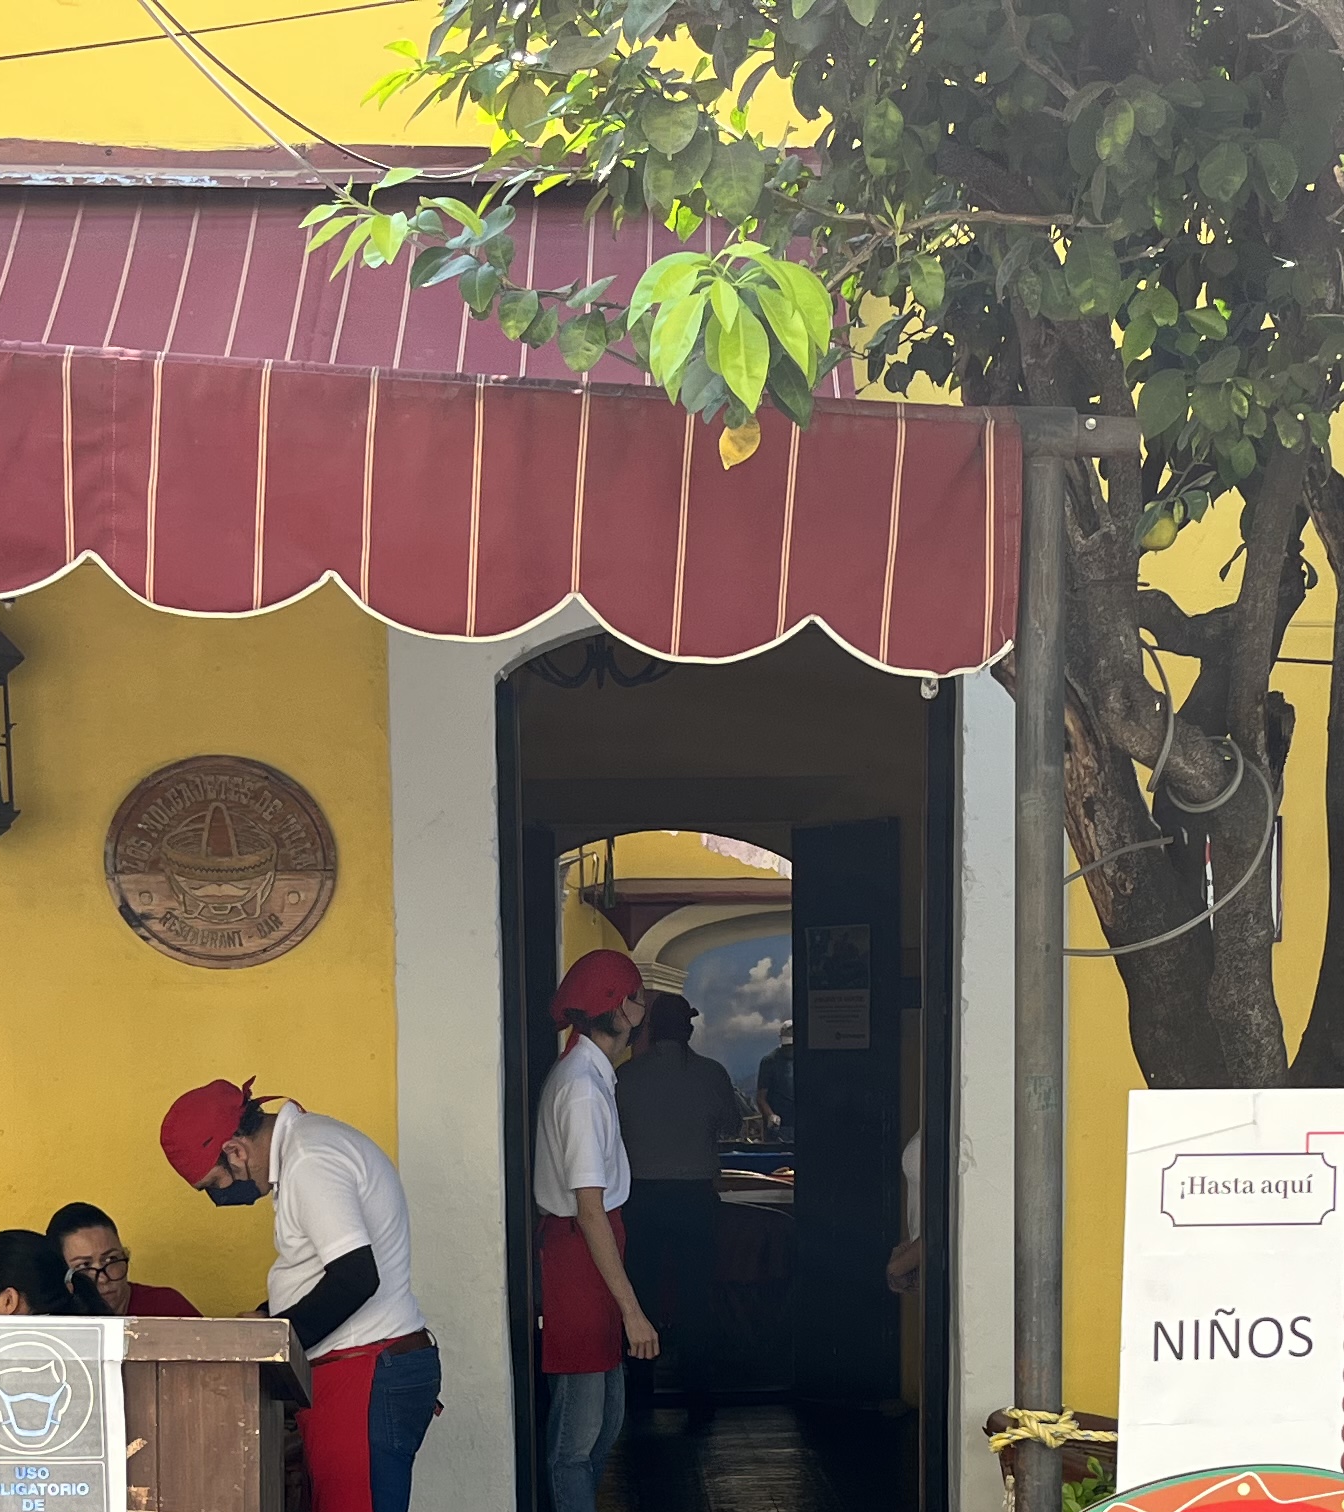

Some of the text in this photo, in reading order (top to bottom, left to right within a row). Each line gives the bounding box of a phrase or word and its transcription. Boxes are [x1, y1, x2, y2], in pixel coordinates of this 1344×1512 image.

[257, 790, 284, 822] DE
[256, 912, 284, 939] BAR
[1178, 1173, 1314, 1200] ¡Hasta aquí
[1152, 1307, 1314, 1362] NIÑOS
[14, 1466, 51, 1480] USO
[21, 1498, 46, 1512] DE
